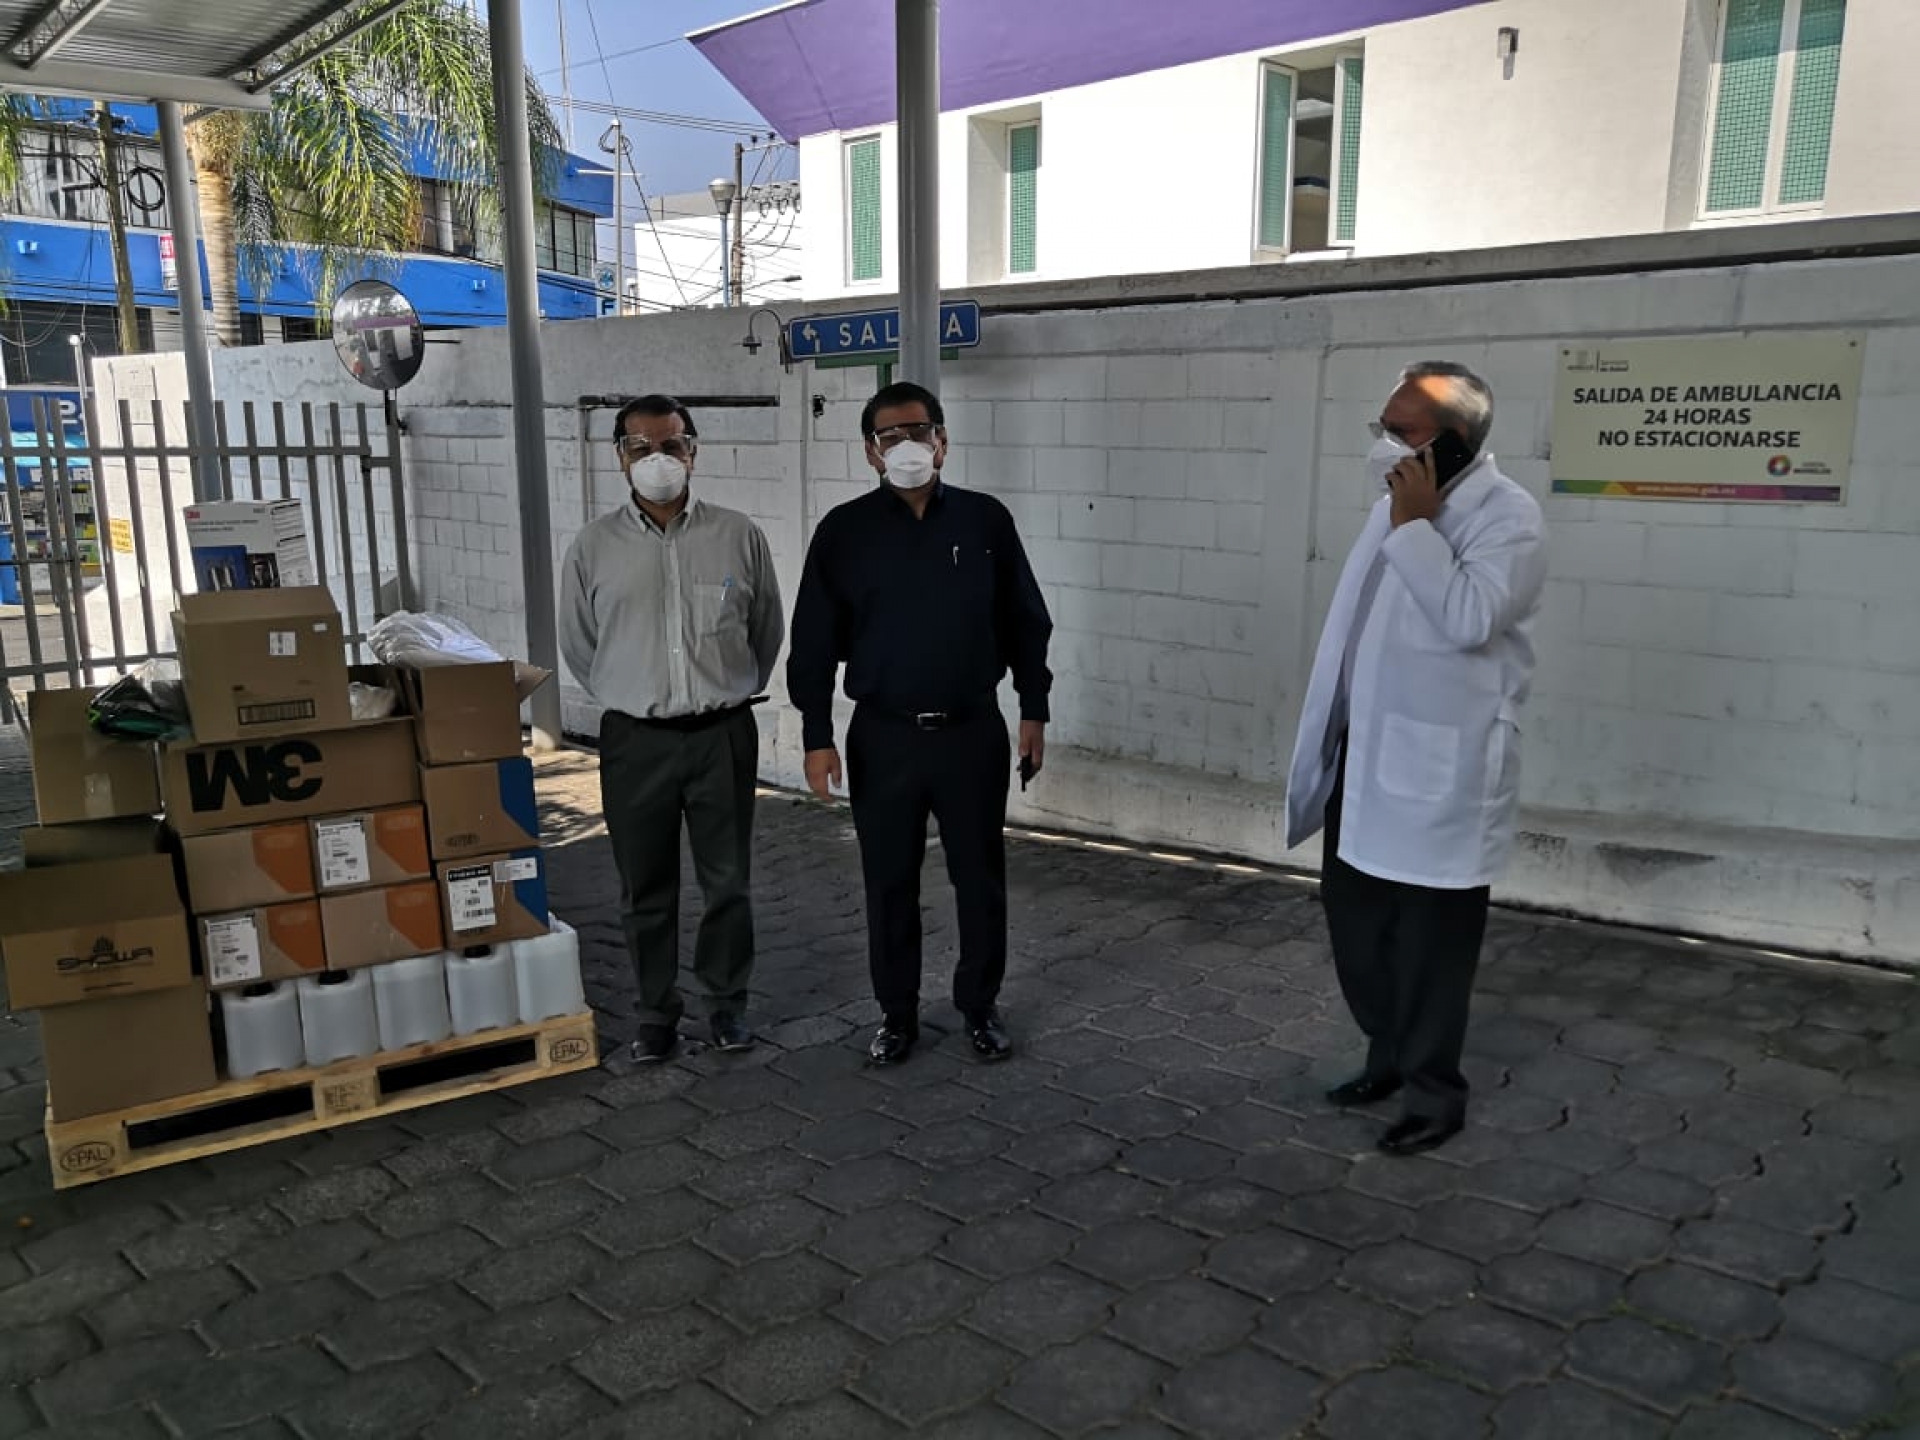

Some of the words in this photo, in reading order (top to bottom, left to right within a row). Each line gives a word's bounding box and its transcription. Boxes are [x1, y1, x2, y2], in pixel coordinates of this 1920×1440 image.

[839, 312, 963, 346] SALA
[1573, 386, 1644, 404] SALIDA
[1651, 386, 1678, 403] DE
[1683, 383, 1841, 402] AMBULANCIA
[1643, 409, 1667, 425] 24
[1673, 408, 1751, 424] HORAS
[1598, 430, 1629, 447] NO
[1634, 430, 1801, 447] ESTACIONARSE
[186, 740, 323, 811] 3M
[555, 1041, 586, 1059] EPAL
[68, 1146, 107, 1167] EPAL
